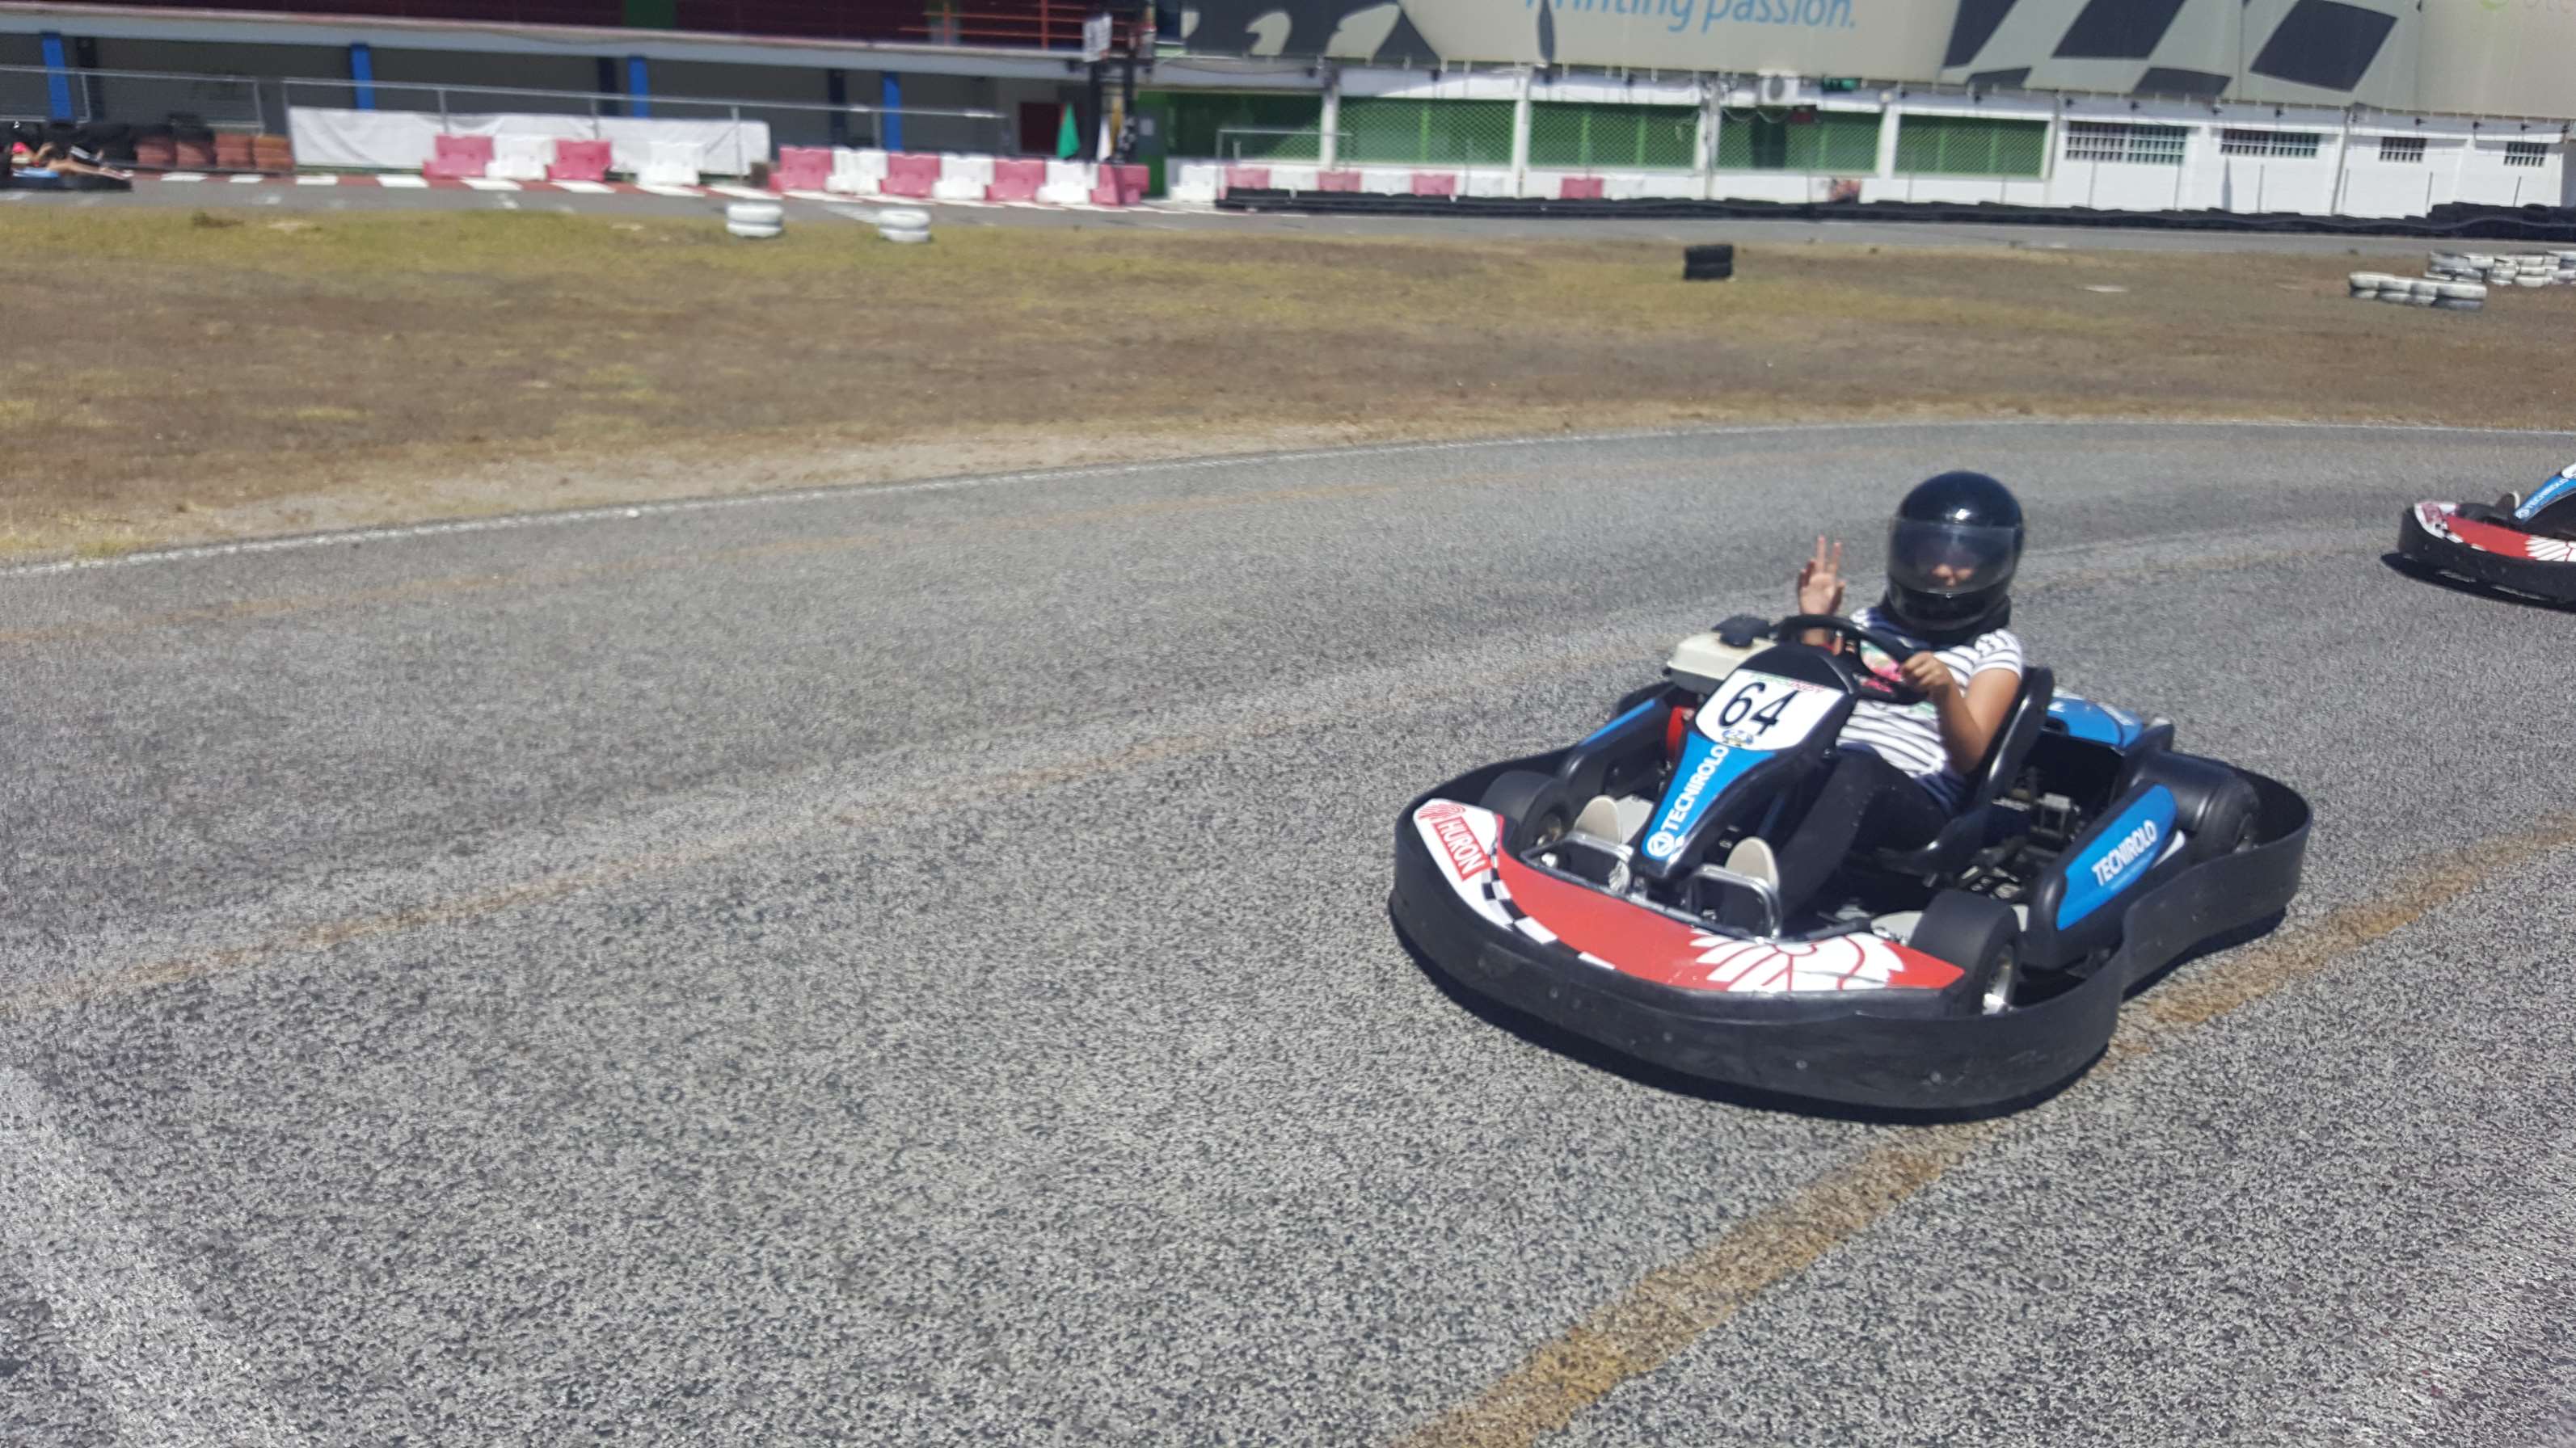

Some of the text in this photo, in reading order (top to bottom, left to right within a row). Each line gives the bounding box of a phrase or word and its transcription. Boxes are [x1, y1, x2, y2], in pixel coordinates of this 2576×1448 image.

[1526, 0, 1856, 33] nting passion.
[1718, 681, 1801, 735] 64
[1660, 744, 1729, 831] TECNIROLO
[1437, 819, 1486, 873] HURON
[2091, 819, 2157, 886] TECNIROLO
